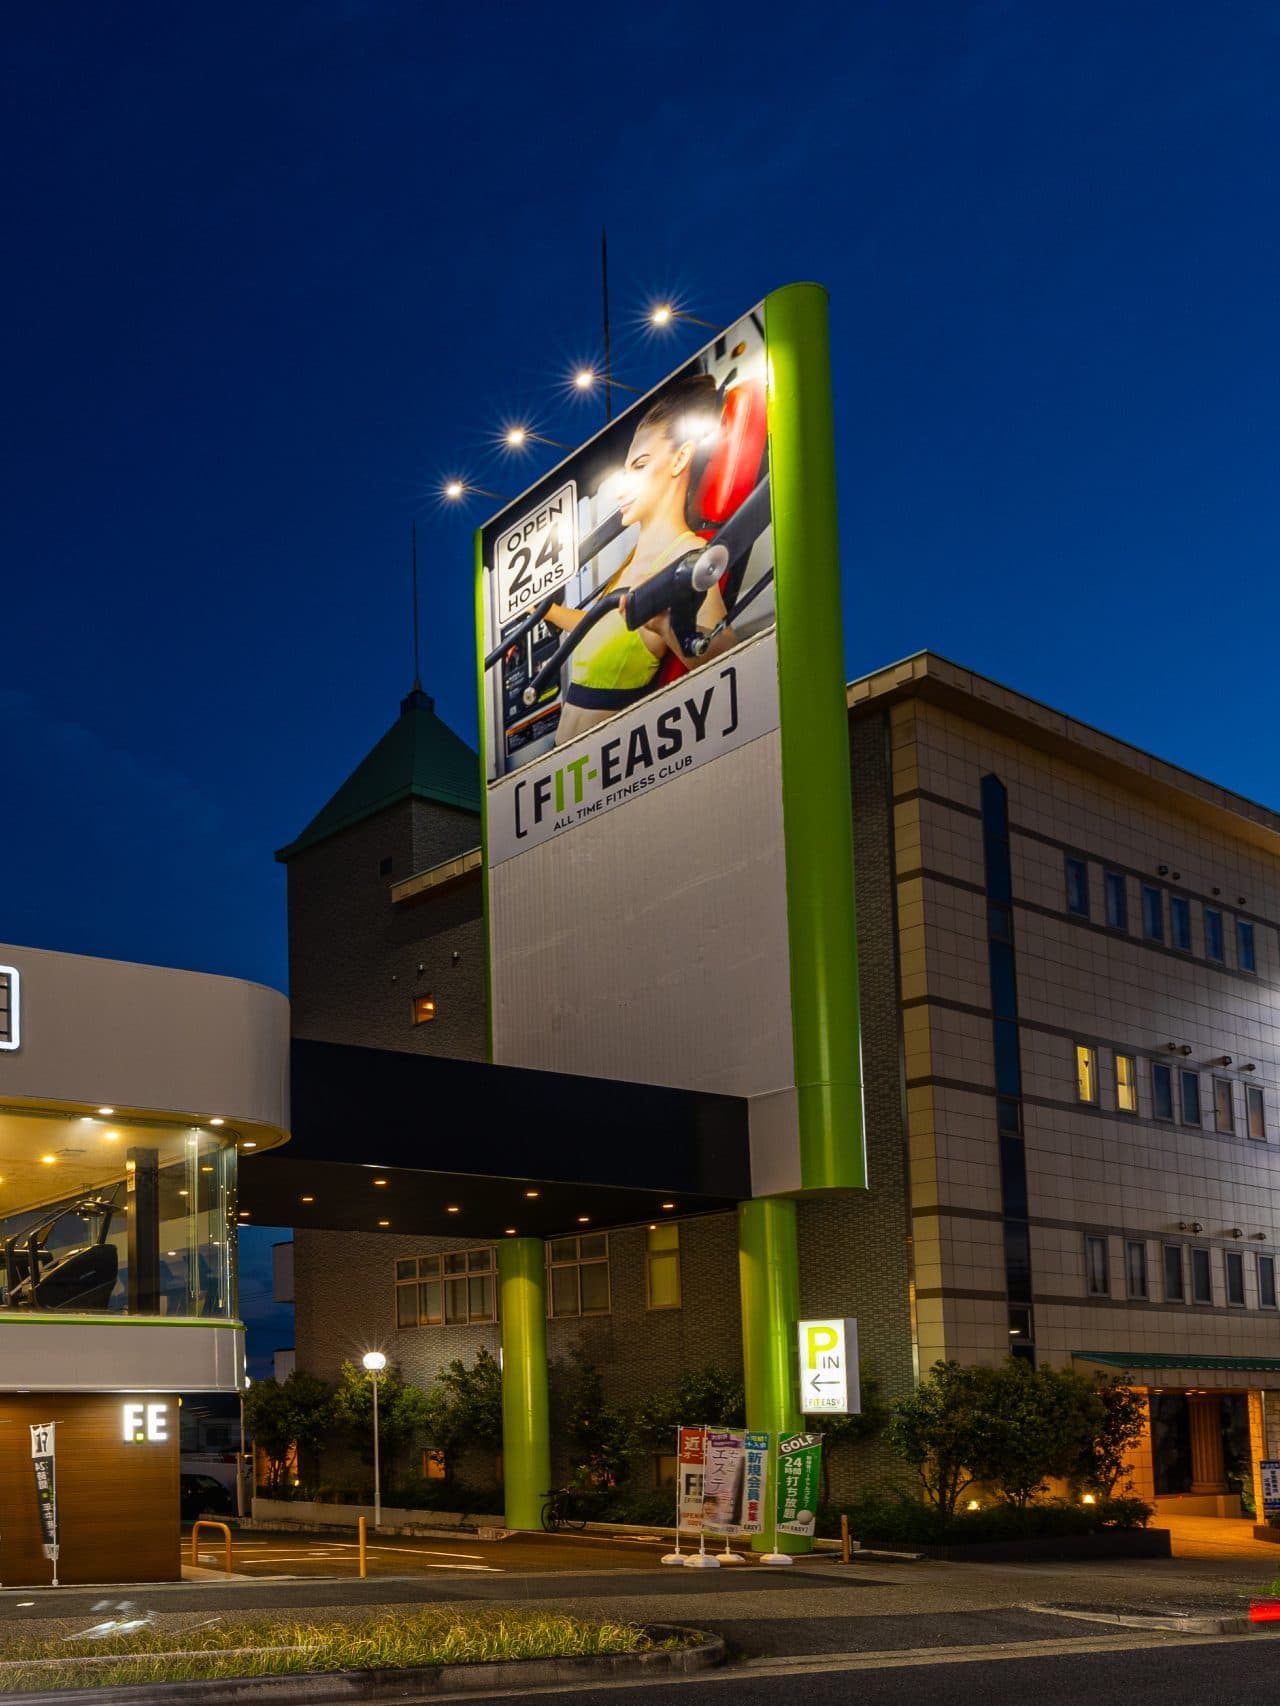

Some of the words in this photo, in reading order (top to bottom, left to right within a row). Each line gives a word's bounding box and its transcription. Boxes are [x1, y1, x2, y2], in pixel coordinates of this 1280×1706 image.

[506, 495, 563, 553] OPEN
[507, 522, 563, 596] 24
[508, 564, 564, 612] HOURS
[554, 813, 574, 831] ALL
[577, 800, 603, 821] TIME
[606, 776, 656, 807] FITNESS
[659, 755, 693, 783] CLUB
[807, 1326, 838, 1370] P
[823, 1355, 839, 1369] IN
[780, 1434, 815, 1453] GOLF
